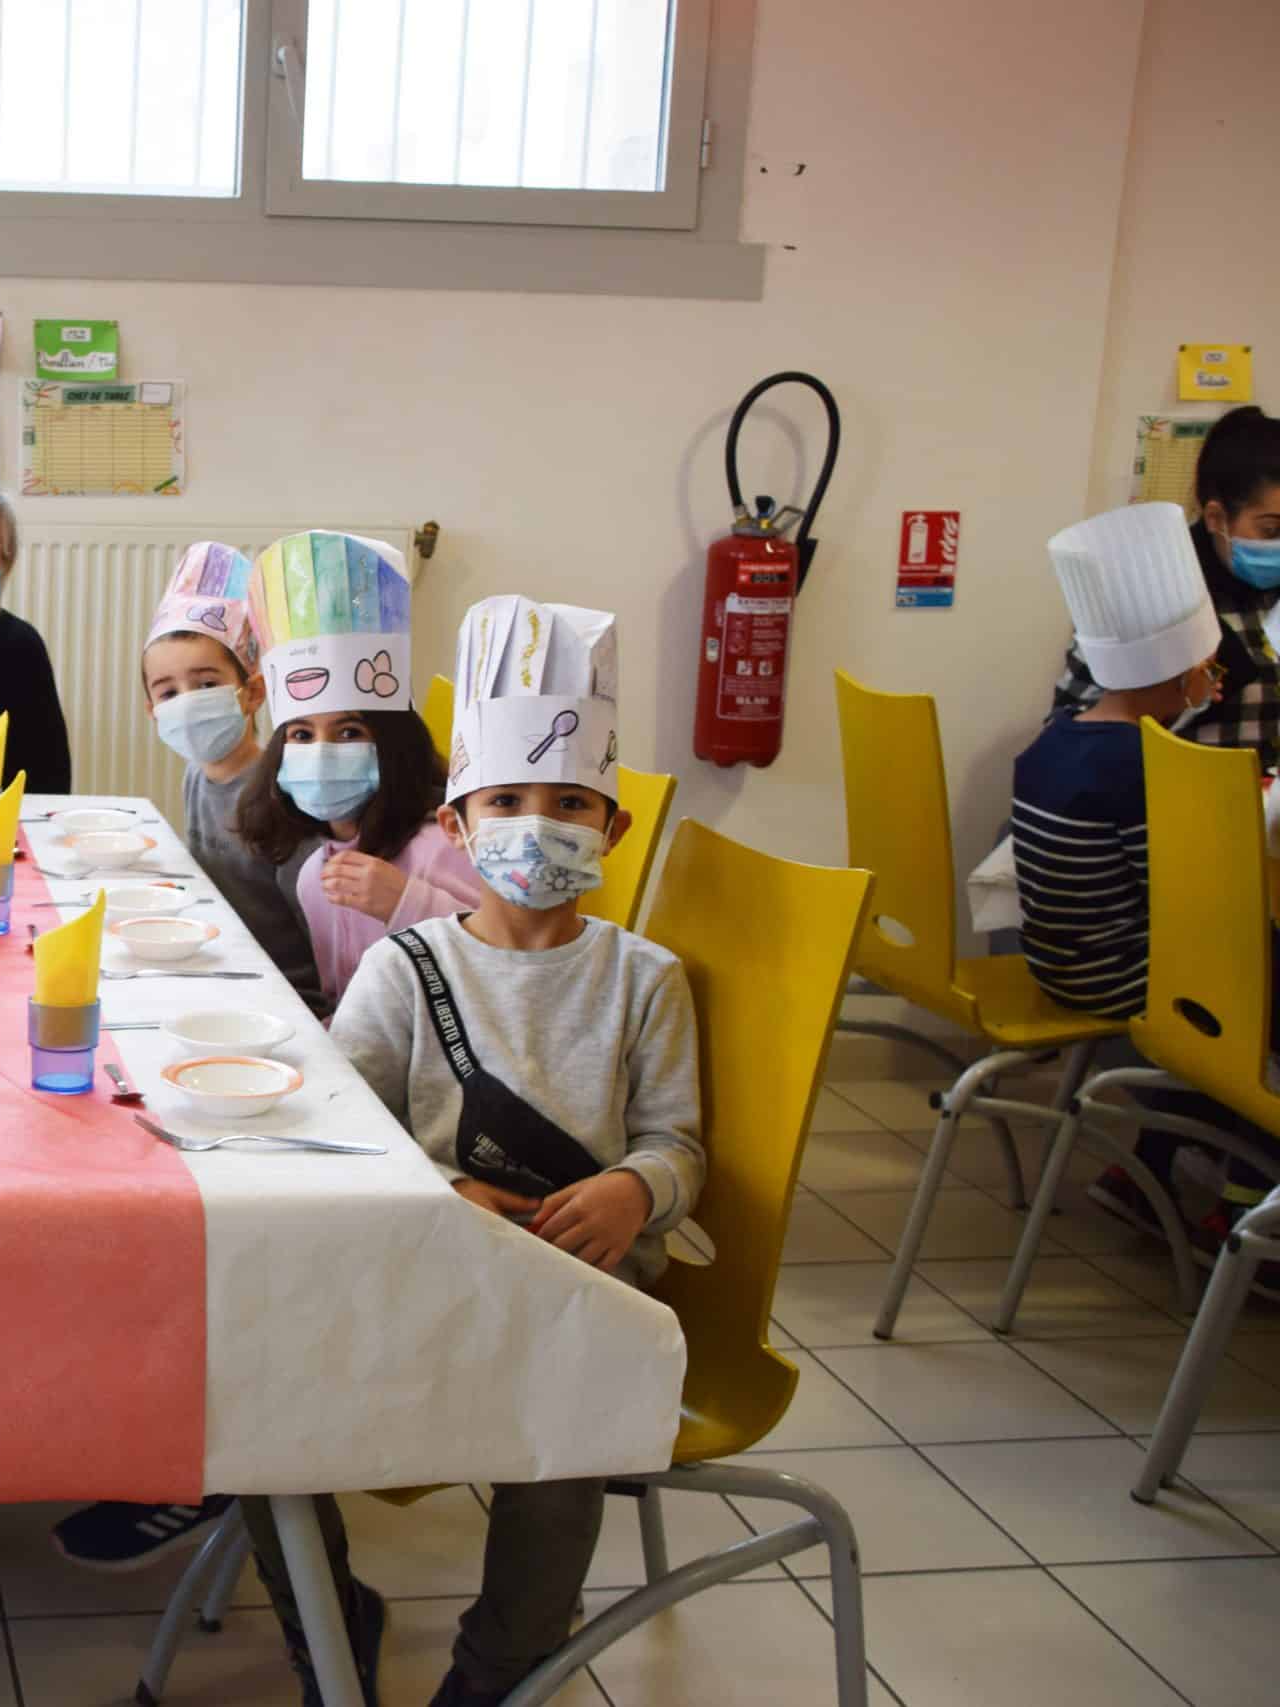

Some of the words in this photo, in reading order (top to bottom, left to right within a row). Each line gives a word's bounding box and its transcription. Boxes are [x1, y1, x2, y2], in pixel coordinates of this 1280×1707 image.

[67, 391, 88, 401] CHEF
[416, 956, 445, 995] LIBERTO
[433, 998, 461, 1042] LIBERTO
